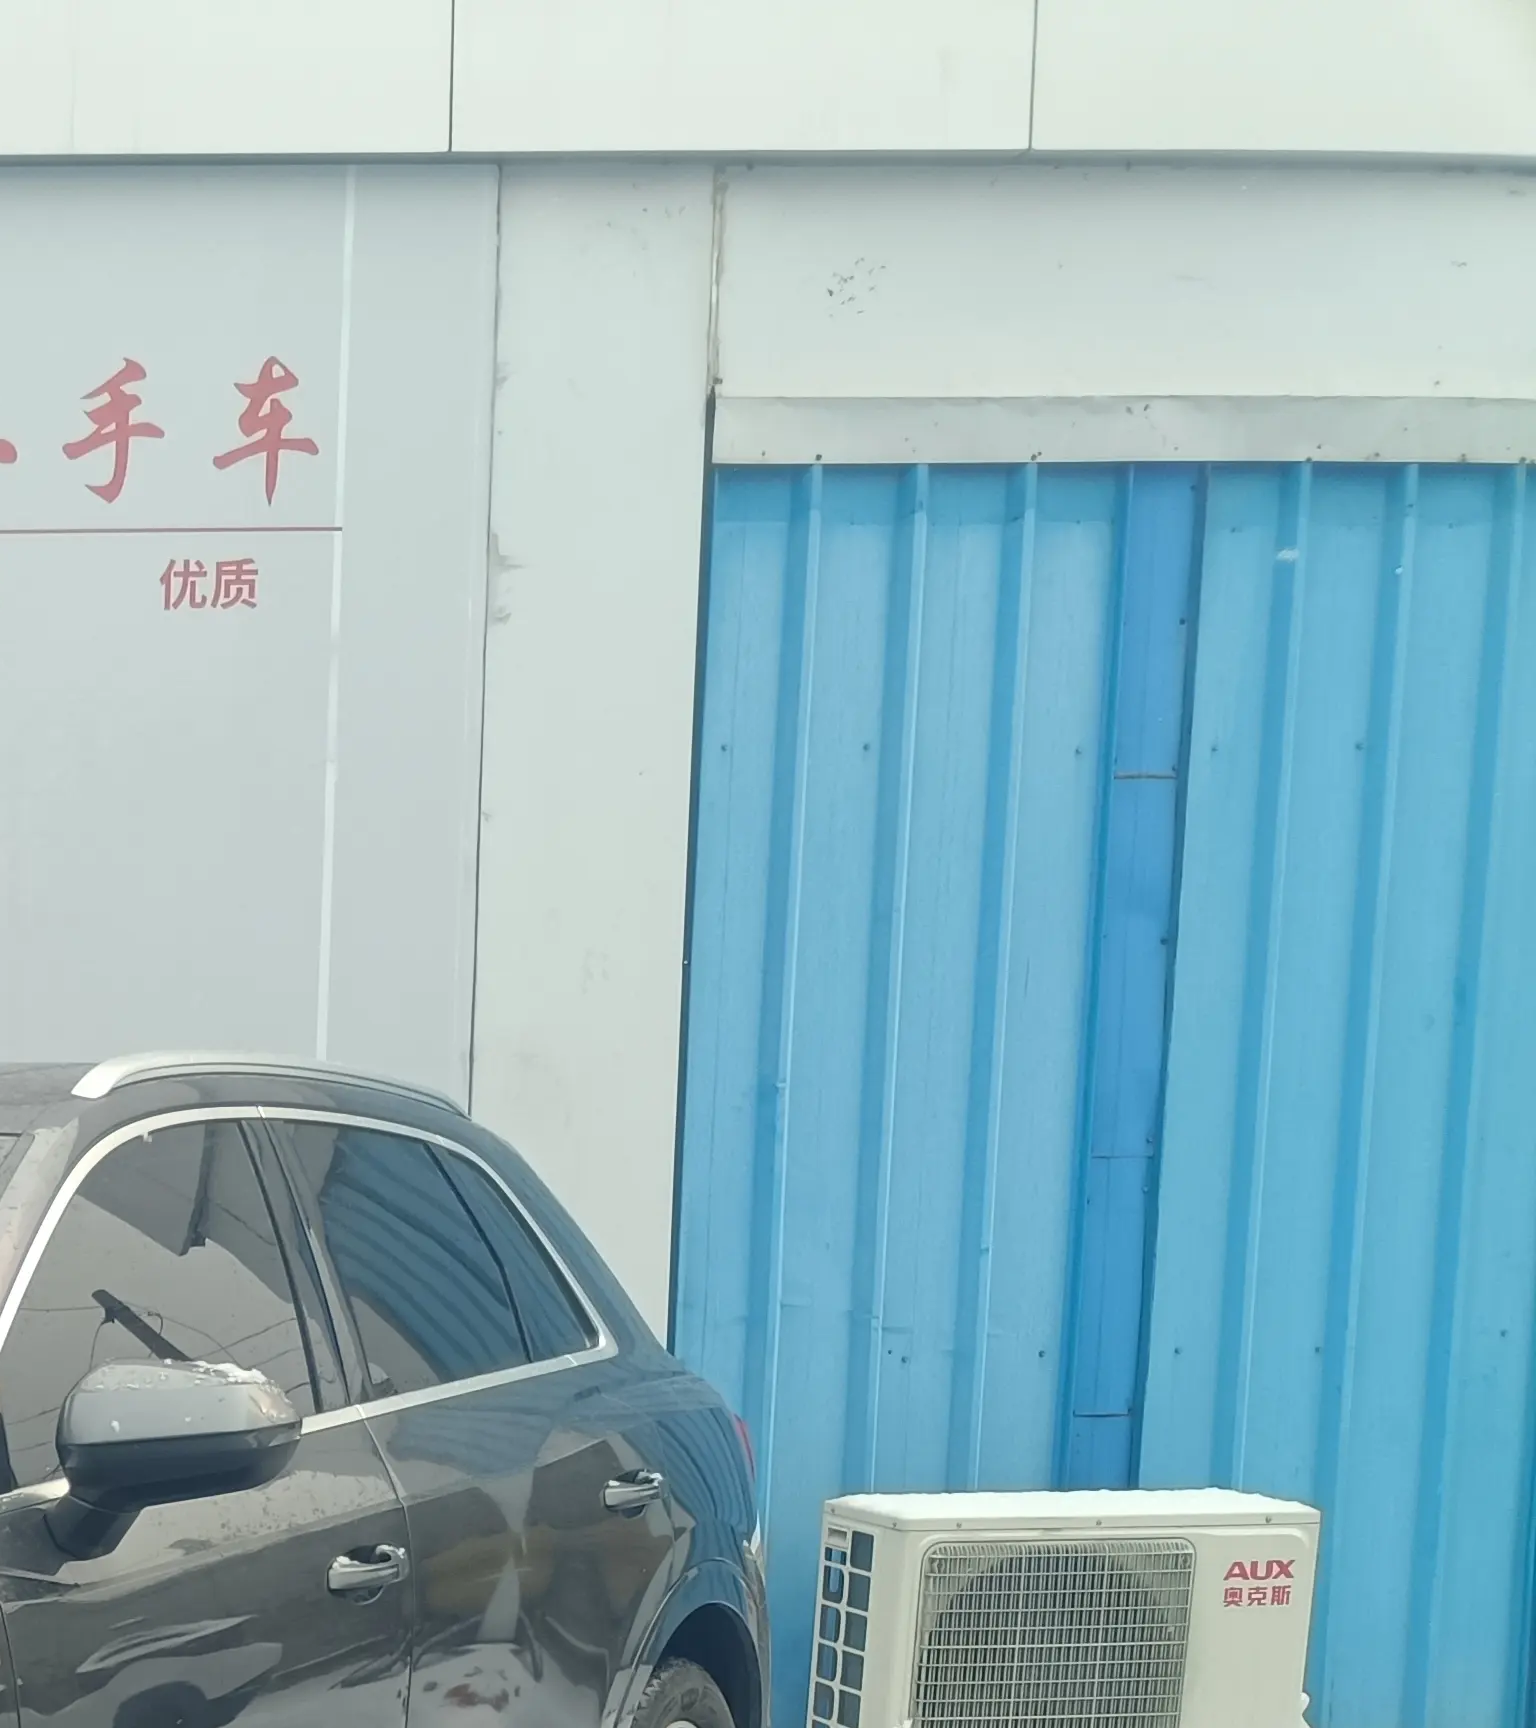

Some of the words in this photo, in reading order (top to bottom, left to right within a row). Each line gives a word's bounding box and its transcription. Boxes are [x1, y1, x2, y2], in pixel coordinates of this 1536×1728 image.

[158, 556, 260, 611] 优质
[1222, 1559, 1296, 1581] AUX
[1223, 1584, 1292, 1607] 奥克斯
